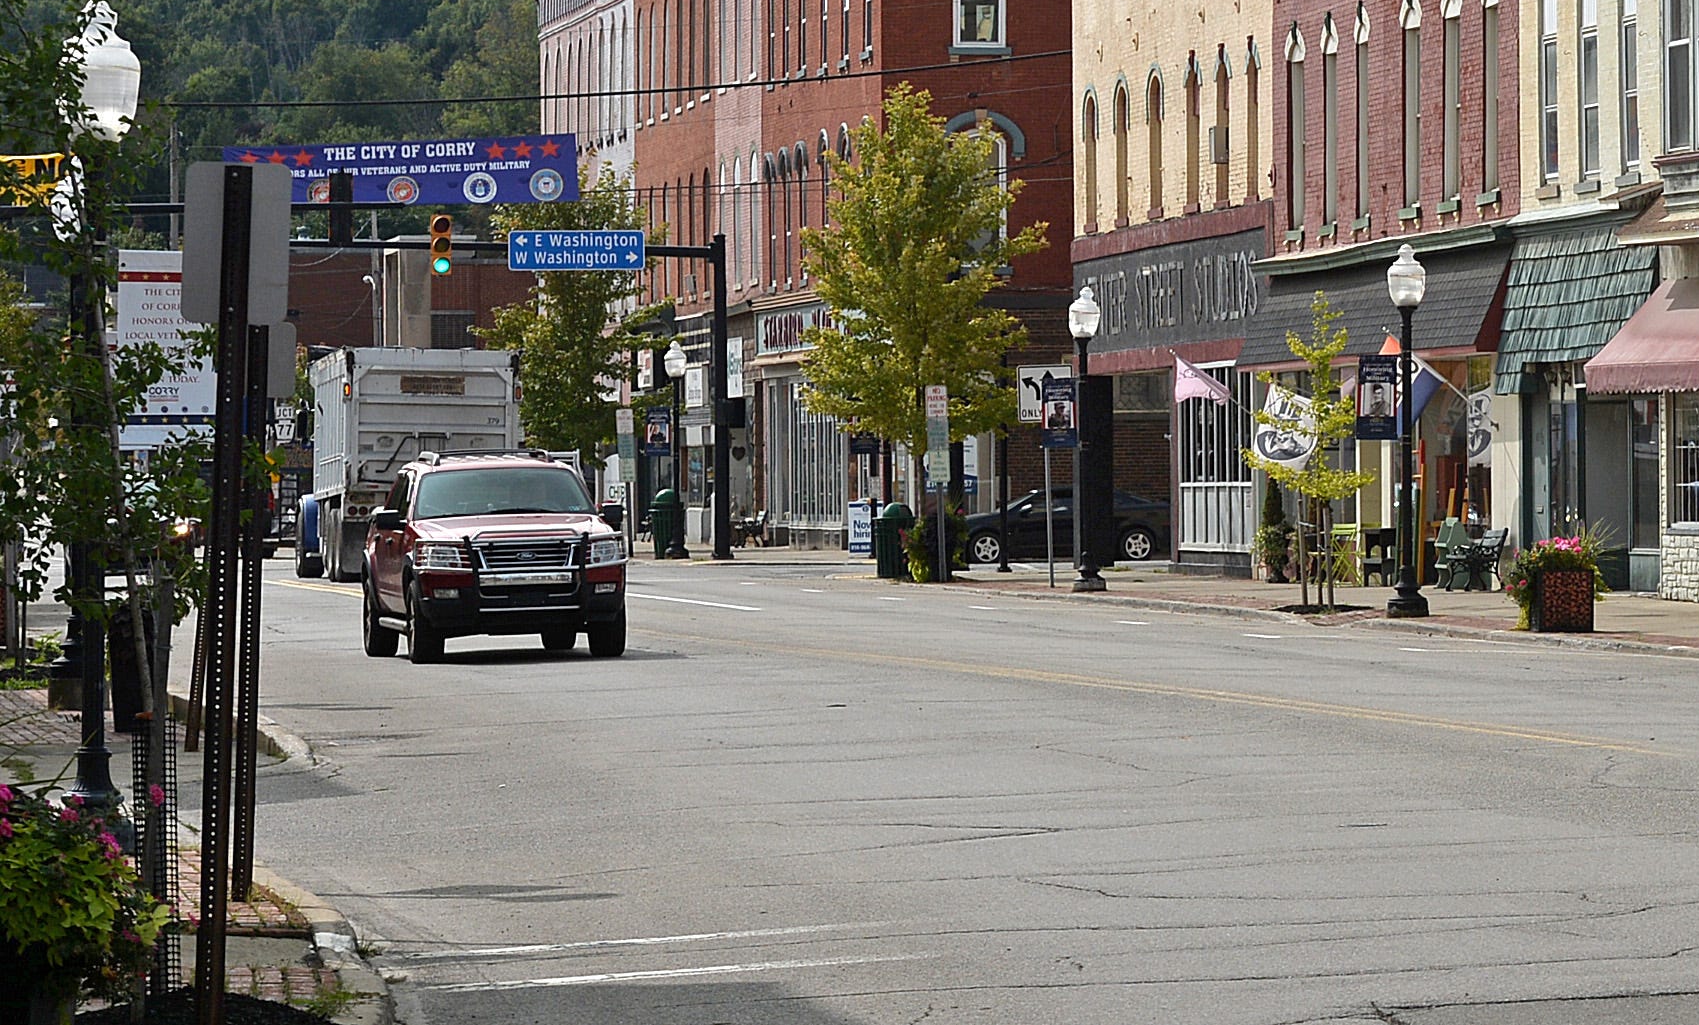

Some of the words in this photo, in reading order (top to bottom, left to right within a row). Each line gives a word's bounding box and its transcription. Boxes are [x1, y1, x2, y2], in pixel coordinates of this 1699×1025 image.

[323, 146, 356, 161] THE
[360, 144, 397, 160] CITY
[400, 143, 421, 159] OF
[425, 141, 476, 158] CORRY
[308, 169, 325, 177] ALL
[360, 165, 407, 176] VETERANS
[409, 164, 427, 174] AND
[429, 163, 461, 174] ACTIVE
[463, 162, 488, 172] DUTY
[489, 160, 531, 171] MILITARY
[534, 234, 543, 247] E
[549, 232, 638, 250] Washington
[514, 251, 528, 265] W
[534, 249, 618, 267] Washington
[144, 288, 162, 297] THE
[165, 288, 182, 297] CIT
[1082, 269, 1127, 336] NTER
[1134, 259, 1185, 331] STREET
[1191, 248, 1258, 326] STUDIOS
[141, 303, 154, 311] OF
[157, 303, 181, 311] COR
[132, 316, 174, 325] HONORS
[125, 332, 155, 340] LOCAL
[1362, 365, 1394, 375] Honoring
[168, 375, 201, 384] TODAY.
[148, 386, 180, 396] CORRY
[276, 407, 294, 418] JCT
[1021, 408, 1042, 418] ONLY
[276, 423, 293, 435] 77
